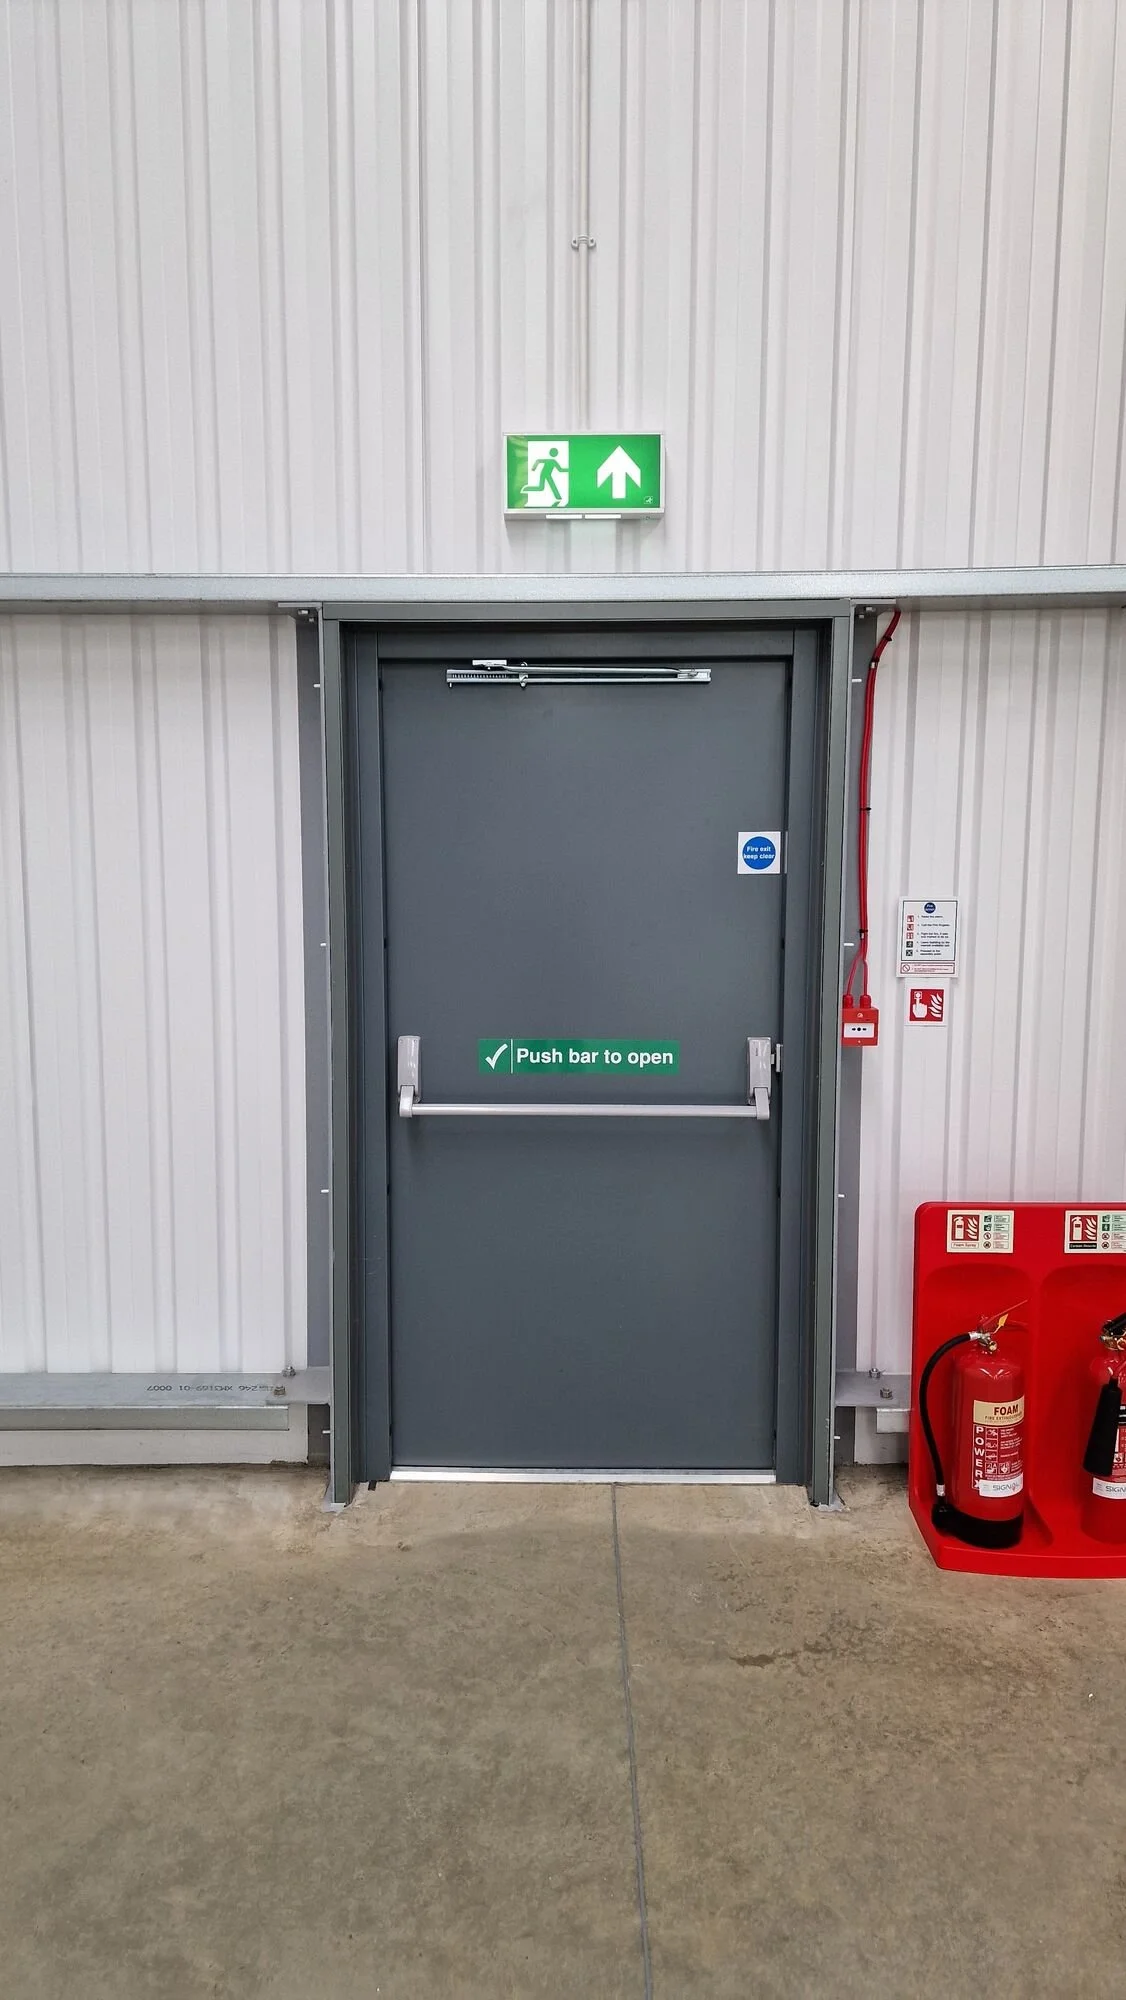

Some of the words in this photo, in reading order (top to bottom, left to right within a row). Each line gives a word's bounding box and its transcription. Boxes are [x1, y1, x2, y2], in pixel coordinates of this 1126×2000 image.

[516, 1048, 563, 1064] Push
[569, 1048, 599, 1064] bar
[604, 1050, 622, 1064] to
[627, 1050, 673, 1068] open
[994, 1404, 1019, 1416] FOAM
